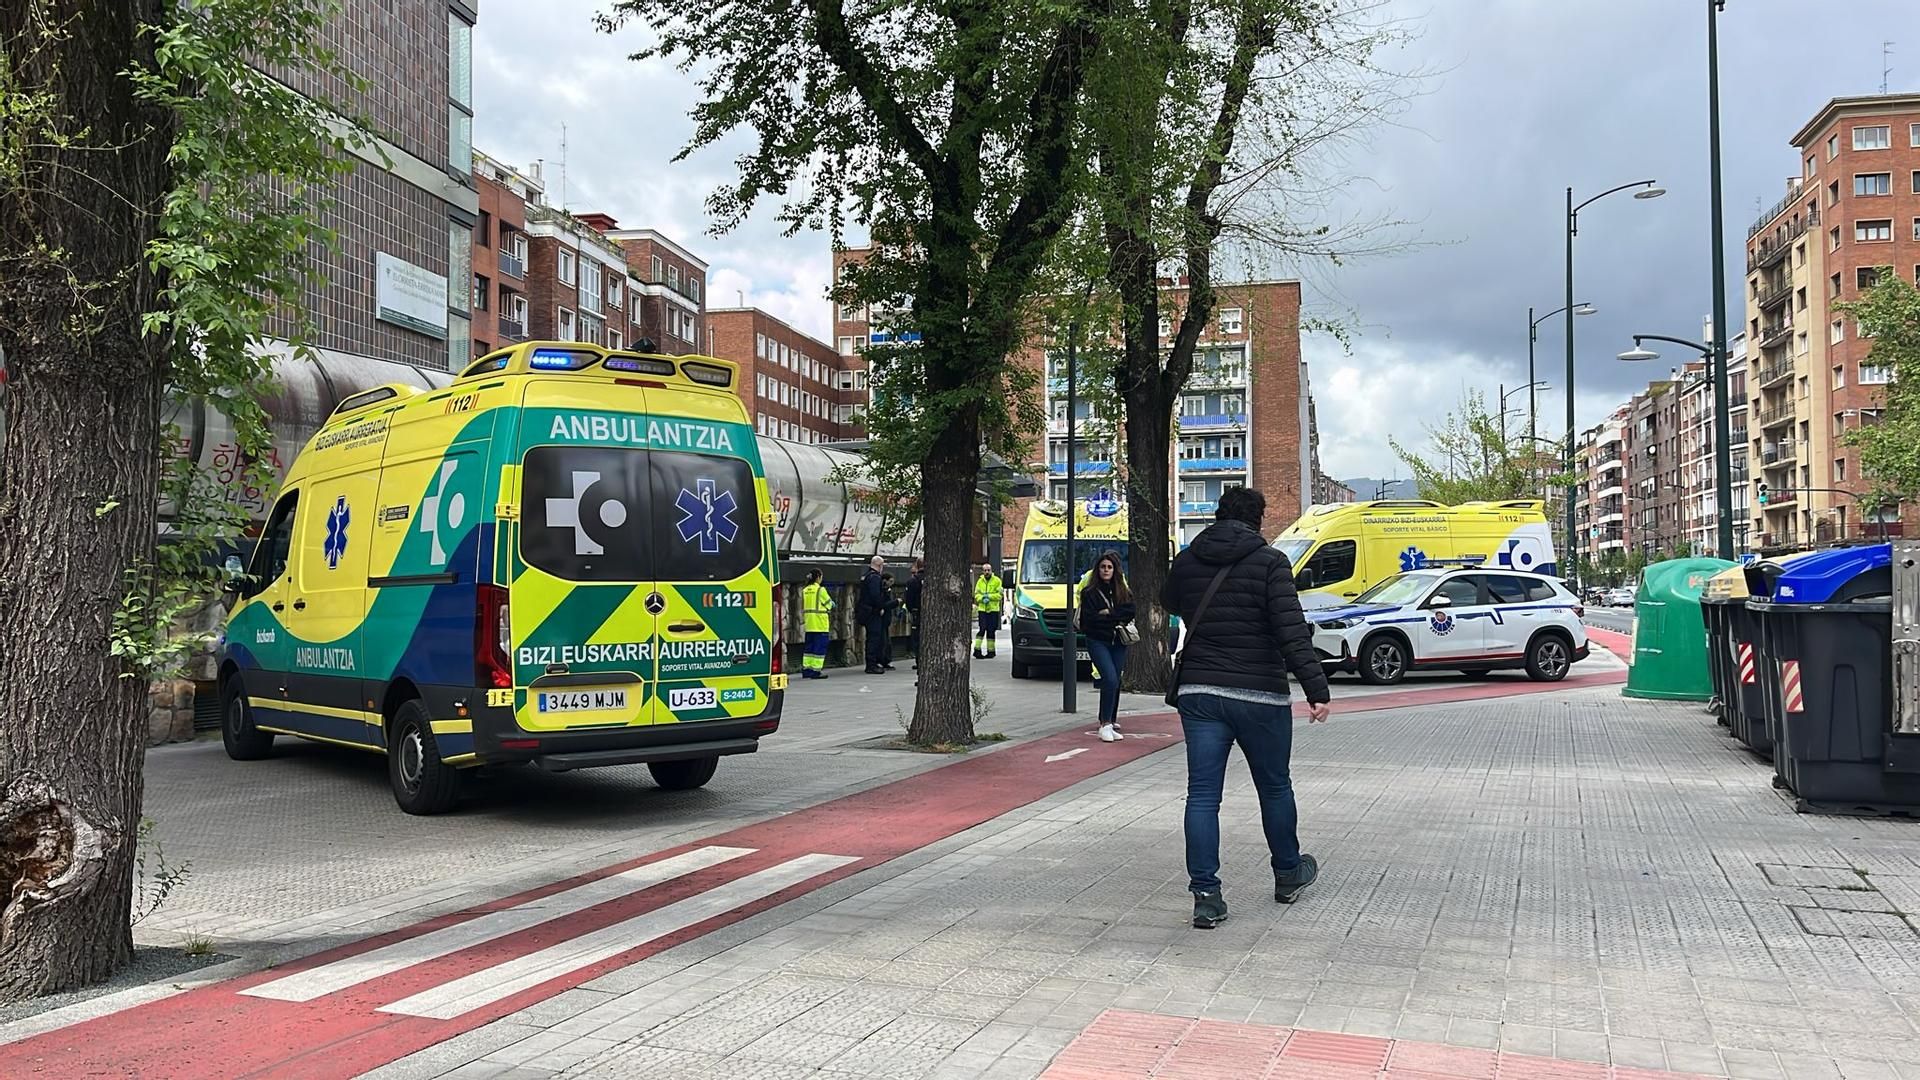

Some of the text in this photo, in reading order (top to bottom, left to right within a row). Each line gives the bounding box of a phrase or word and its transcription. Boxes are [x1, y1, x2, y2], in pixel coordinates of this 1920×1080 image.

[452, 395, 472, 413] 112
[550, 414, 733, 451] ANBULANTZIA
[714, 592, 743, 608] 112
[296, 647, 355, 671] ANBULANTZIA
[519, 639, 765, 666] BIZI EUSKARRI AURRERATUA
[661, 661, 731, 672] SOPORTE VITAL AVANZADO
[549, 692, 624, 710] 3449 MJM
[672, 691, 714, 707] U-633
[723, 690, 753, 700] S-240.2
